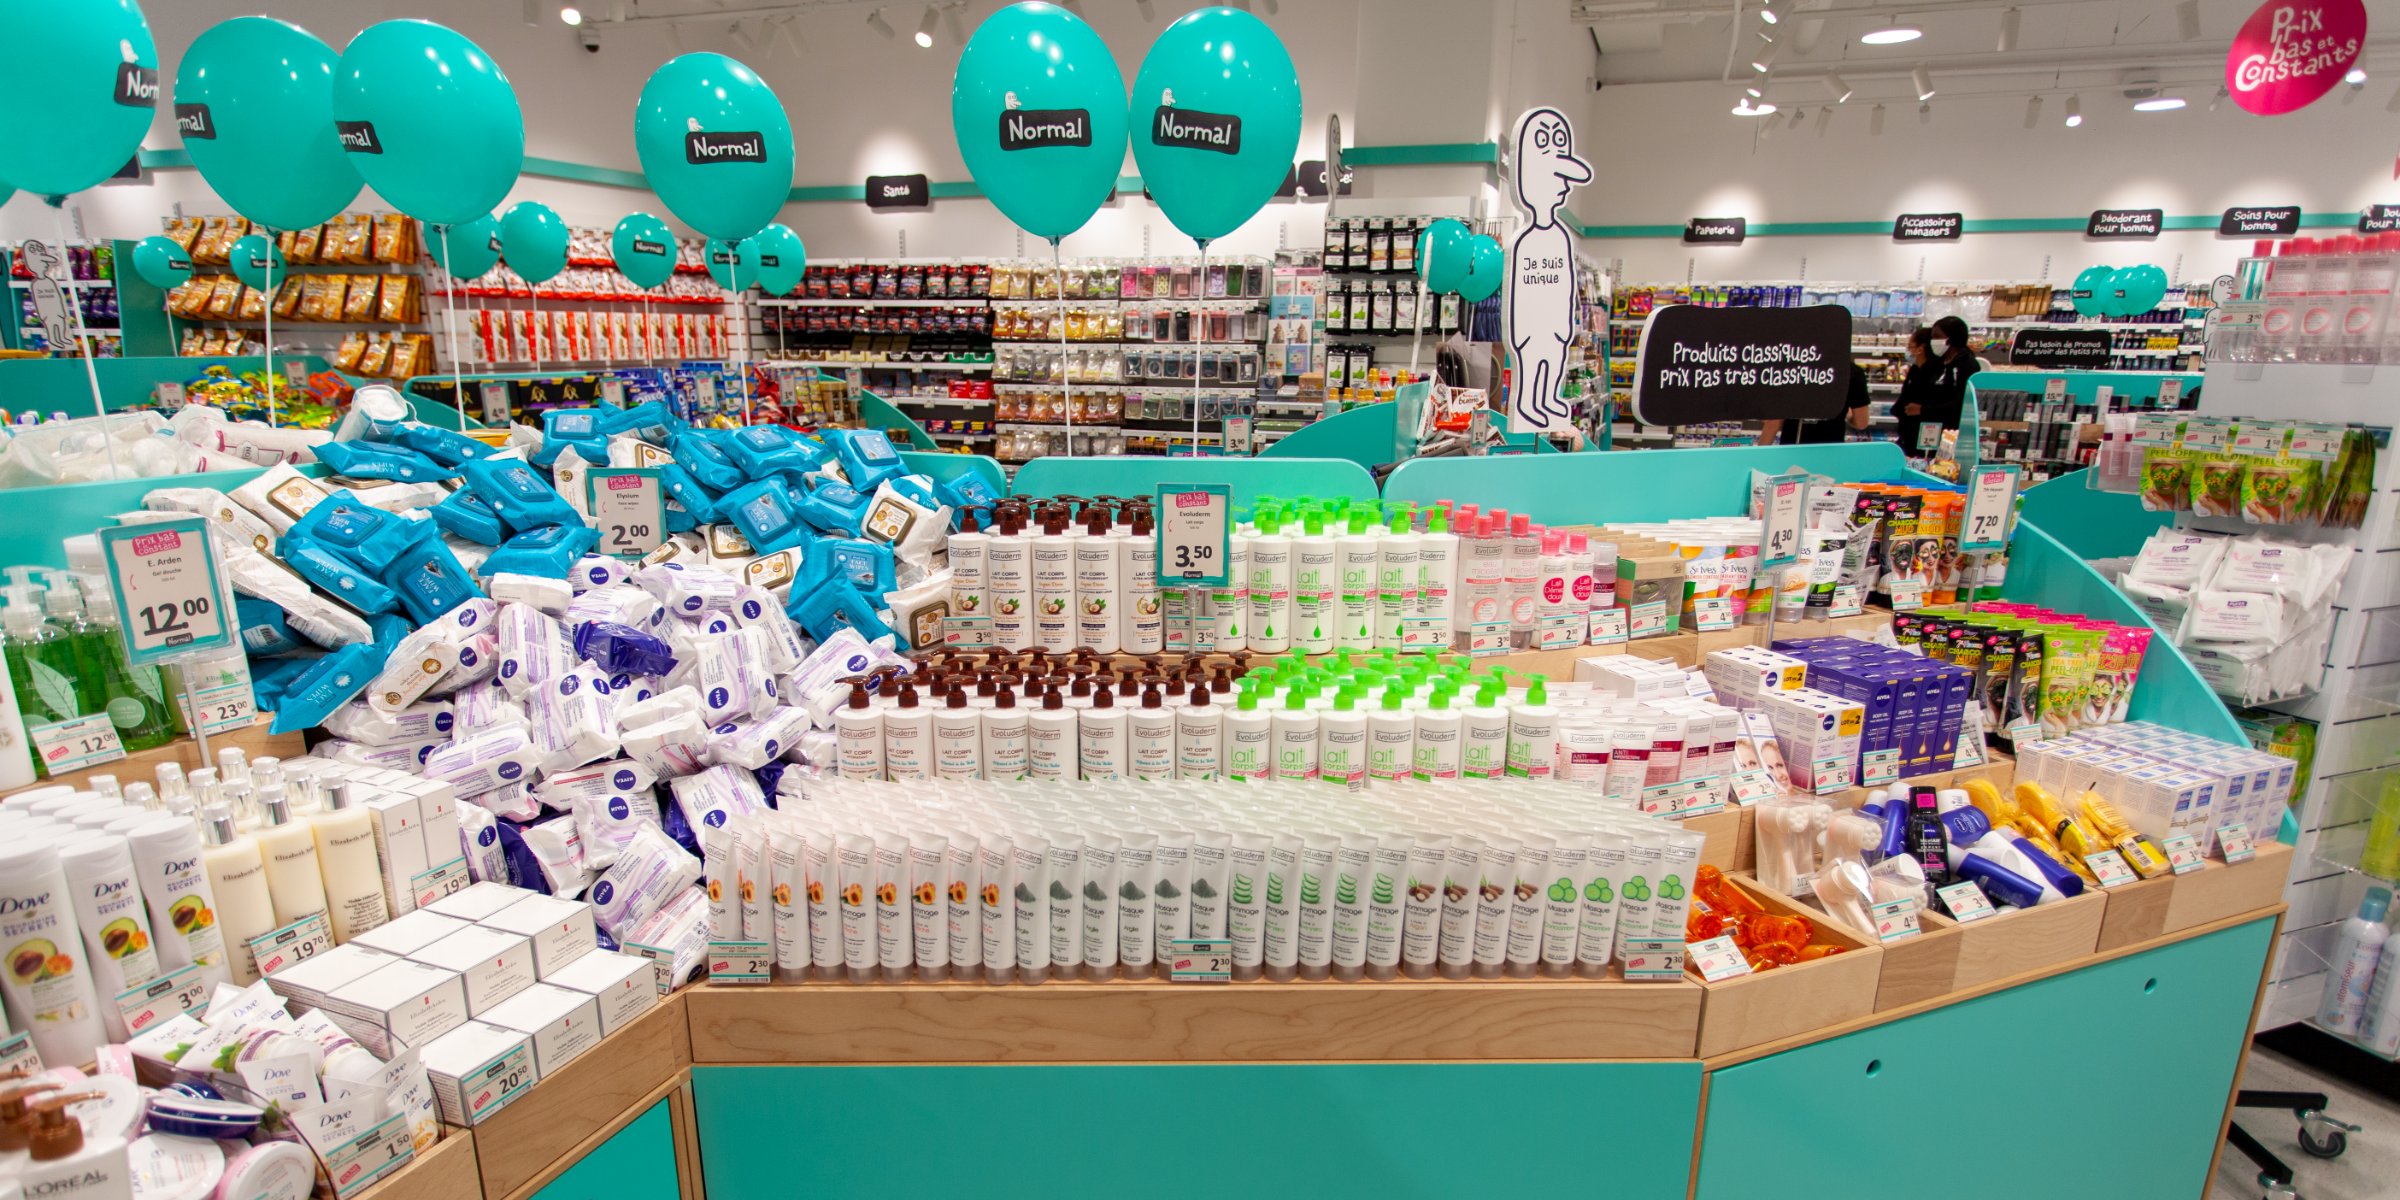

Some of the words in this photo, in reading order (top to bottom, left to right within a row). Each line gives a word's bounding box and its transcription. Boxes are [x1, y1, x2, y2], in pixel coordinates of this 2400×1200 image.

[2270, 6, 2322, 43] Prix
[2268, 34, 2311, 65] bas
[2317, 36, 2335, 50] et
[1008, 115, 1082, 143] Normal
[1160, 113, 1232, 145] Normal
[693, 136, 759, 159] Normal
[883, 178, 910, 197] Santé
[1901, 216, 1956, 228] Accessoires
[2101, 213, 2152, 223] Déodorant
[2233, 211, 2261, 220] Soins
[1905, 226, 1950, 238] ménagers
[2120, 223, 2154, 233] homme
[2241, 221, 2277, 231] homme
[635, 241, 664, 254] Normal
[1523, 257, 1536, 270] Je
[1542, 257, 1563, 270] suis
[1523, 271, 1559, 285] unique
[1673, 342, 1737, 364] Produits
[1724, 365, 1757, 386] très
[157, 556, 182, 566] Arden
[1700, 564, 1717, 574] Ives
[714, 689, 723, 706] NIVEA
[1876, 693, 1890, 701] NIVEA
[1926, 688, 1940, 696] NIVEA
[500, 765, 521, 775] NIVEA
[616, 774, 634, 785] NIVEA
[611, 804, 627, 812] NIVEA
[484, 828, 492, 845] NIVEA
[164, 857, 197, 875] Dove
[94, 878, 130, 898] Dove
[168, 878, 203, 892] SECRETS
[597, 884, 611, 902] NIVEA
[263, 1066, 292, 1081] Dove
[319, 1108, 352, 1128] Dove
